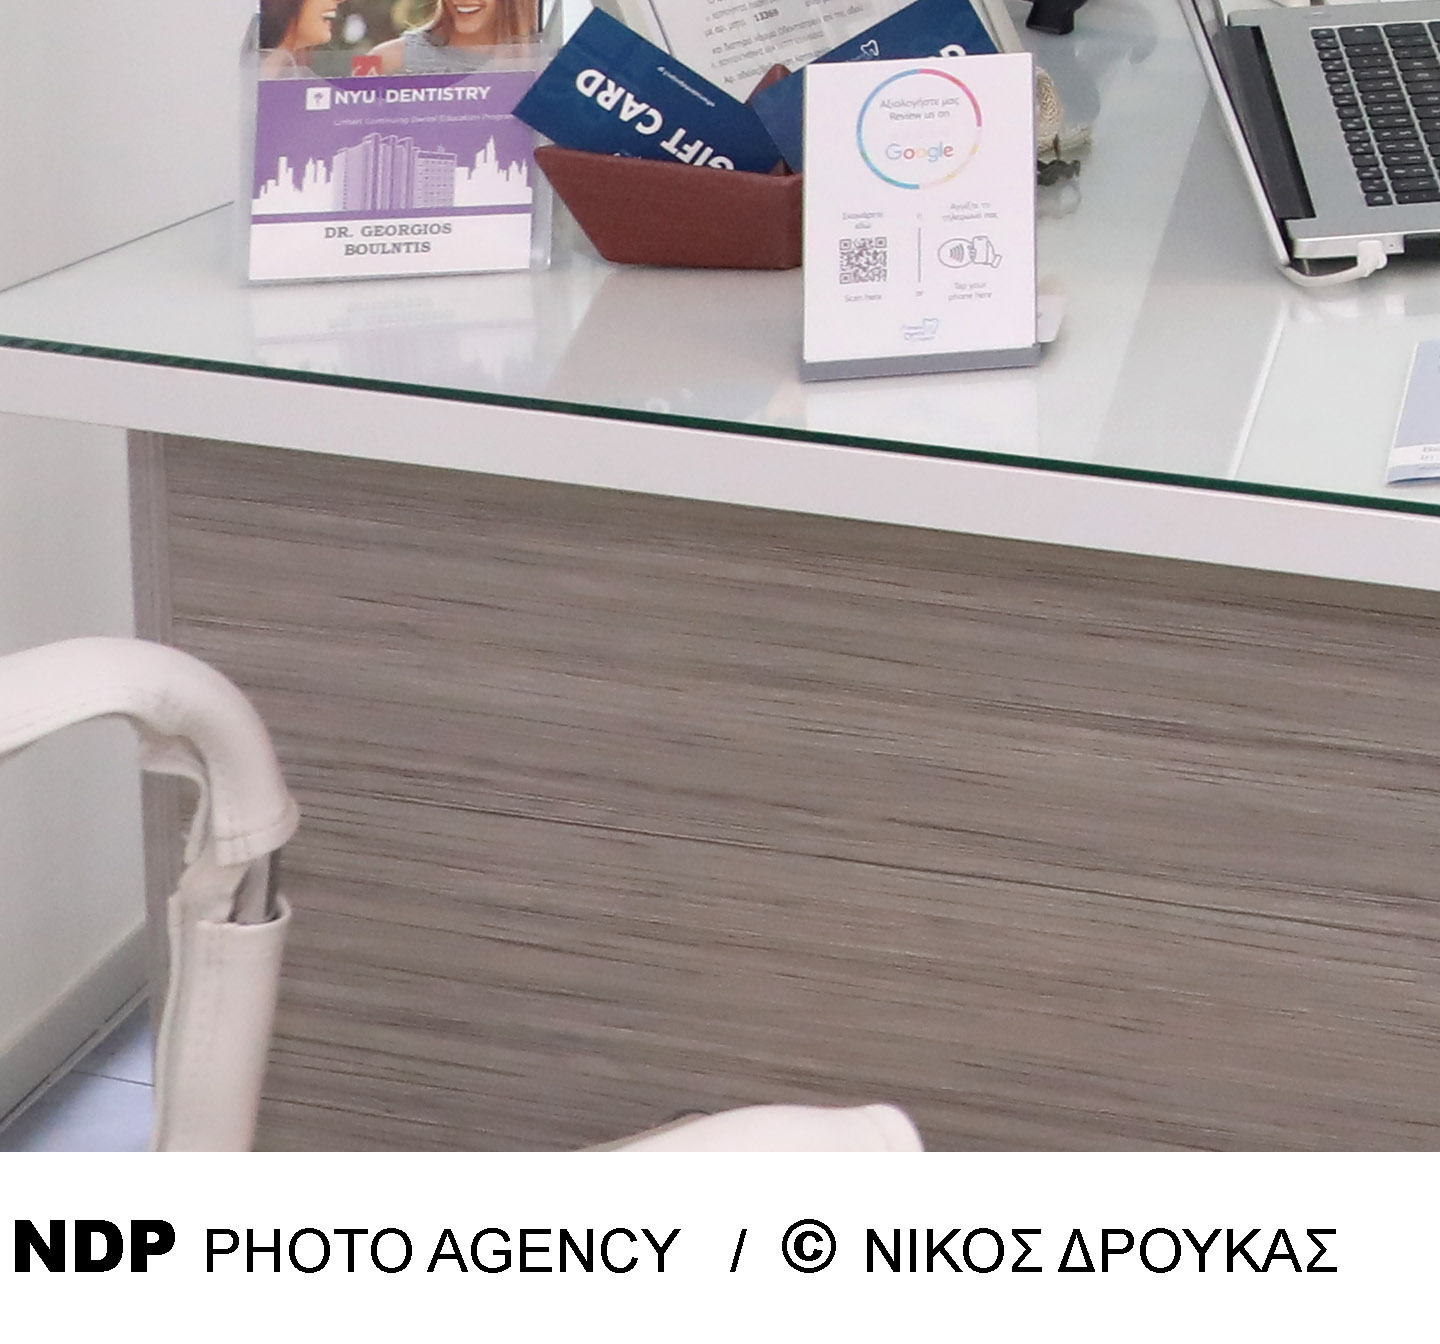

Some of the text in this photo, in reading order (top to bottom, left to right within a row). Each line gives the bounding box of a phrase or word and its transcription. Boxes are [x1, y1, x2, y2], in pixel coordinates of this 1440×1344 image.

[335, 86, 491, 105] NYU DENTISTRY
[575, 69, 663, 135] CARD
[885, 142, 954, 163] Google
[325, 223, 452, 239] DR. GEORGIOS
[344, 241, 431, 256] BOULNTIS
